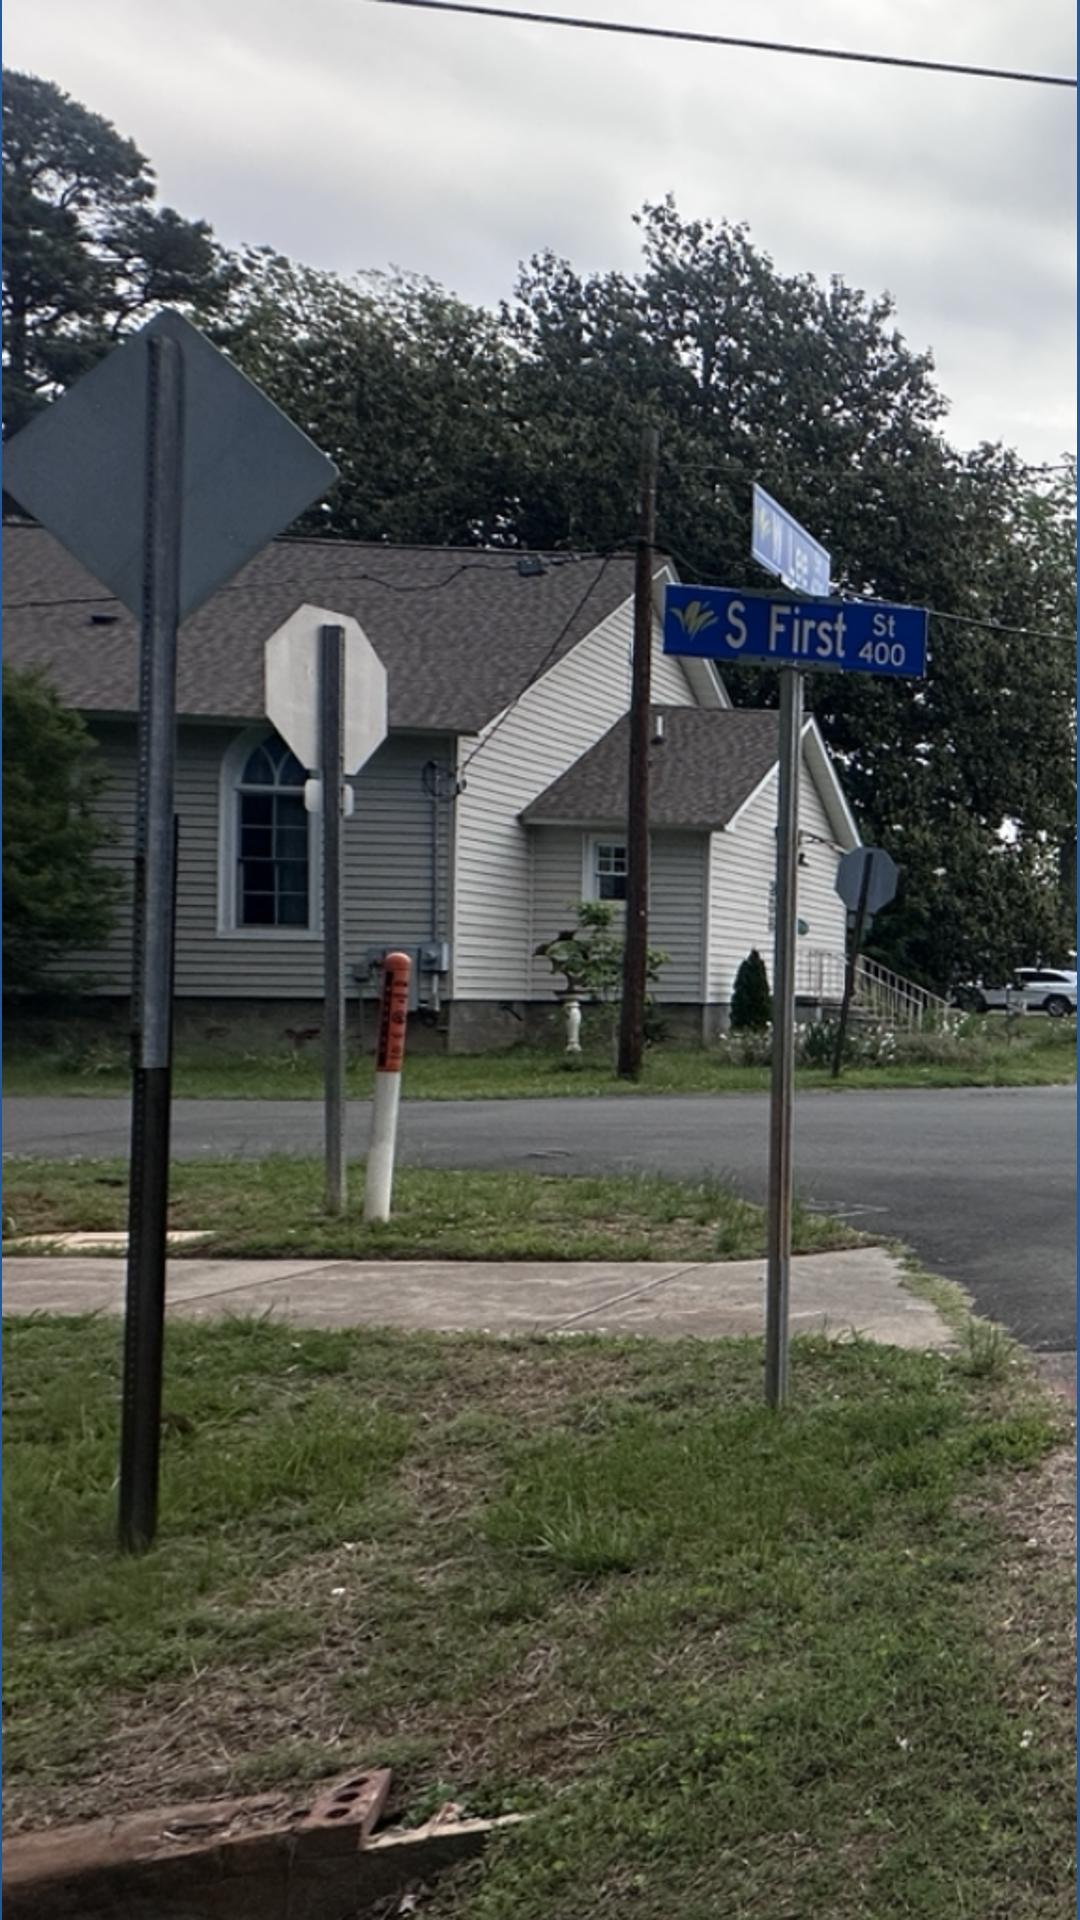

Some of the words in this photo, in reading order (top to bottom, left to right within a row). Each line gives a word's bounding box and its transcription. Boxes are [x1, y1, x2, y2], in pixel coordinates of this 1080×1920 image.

[725, 600, 748, 649] S
[768, 603, 847, 658] First
[872, 613, 896, 638] St
[858, 641, 906, 667] 400
